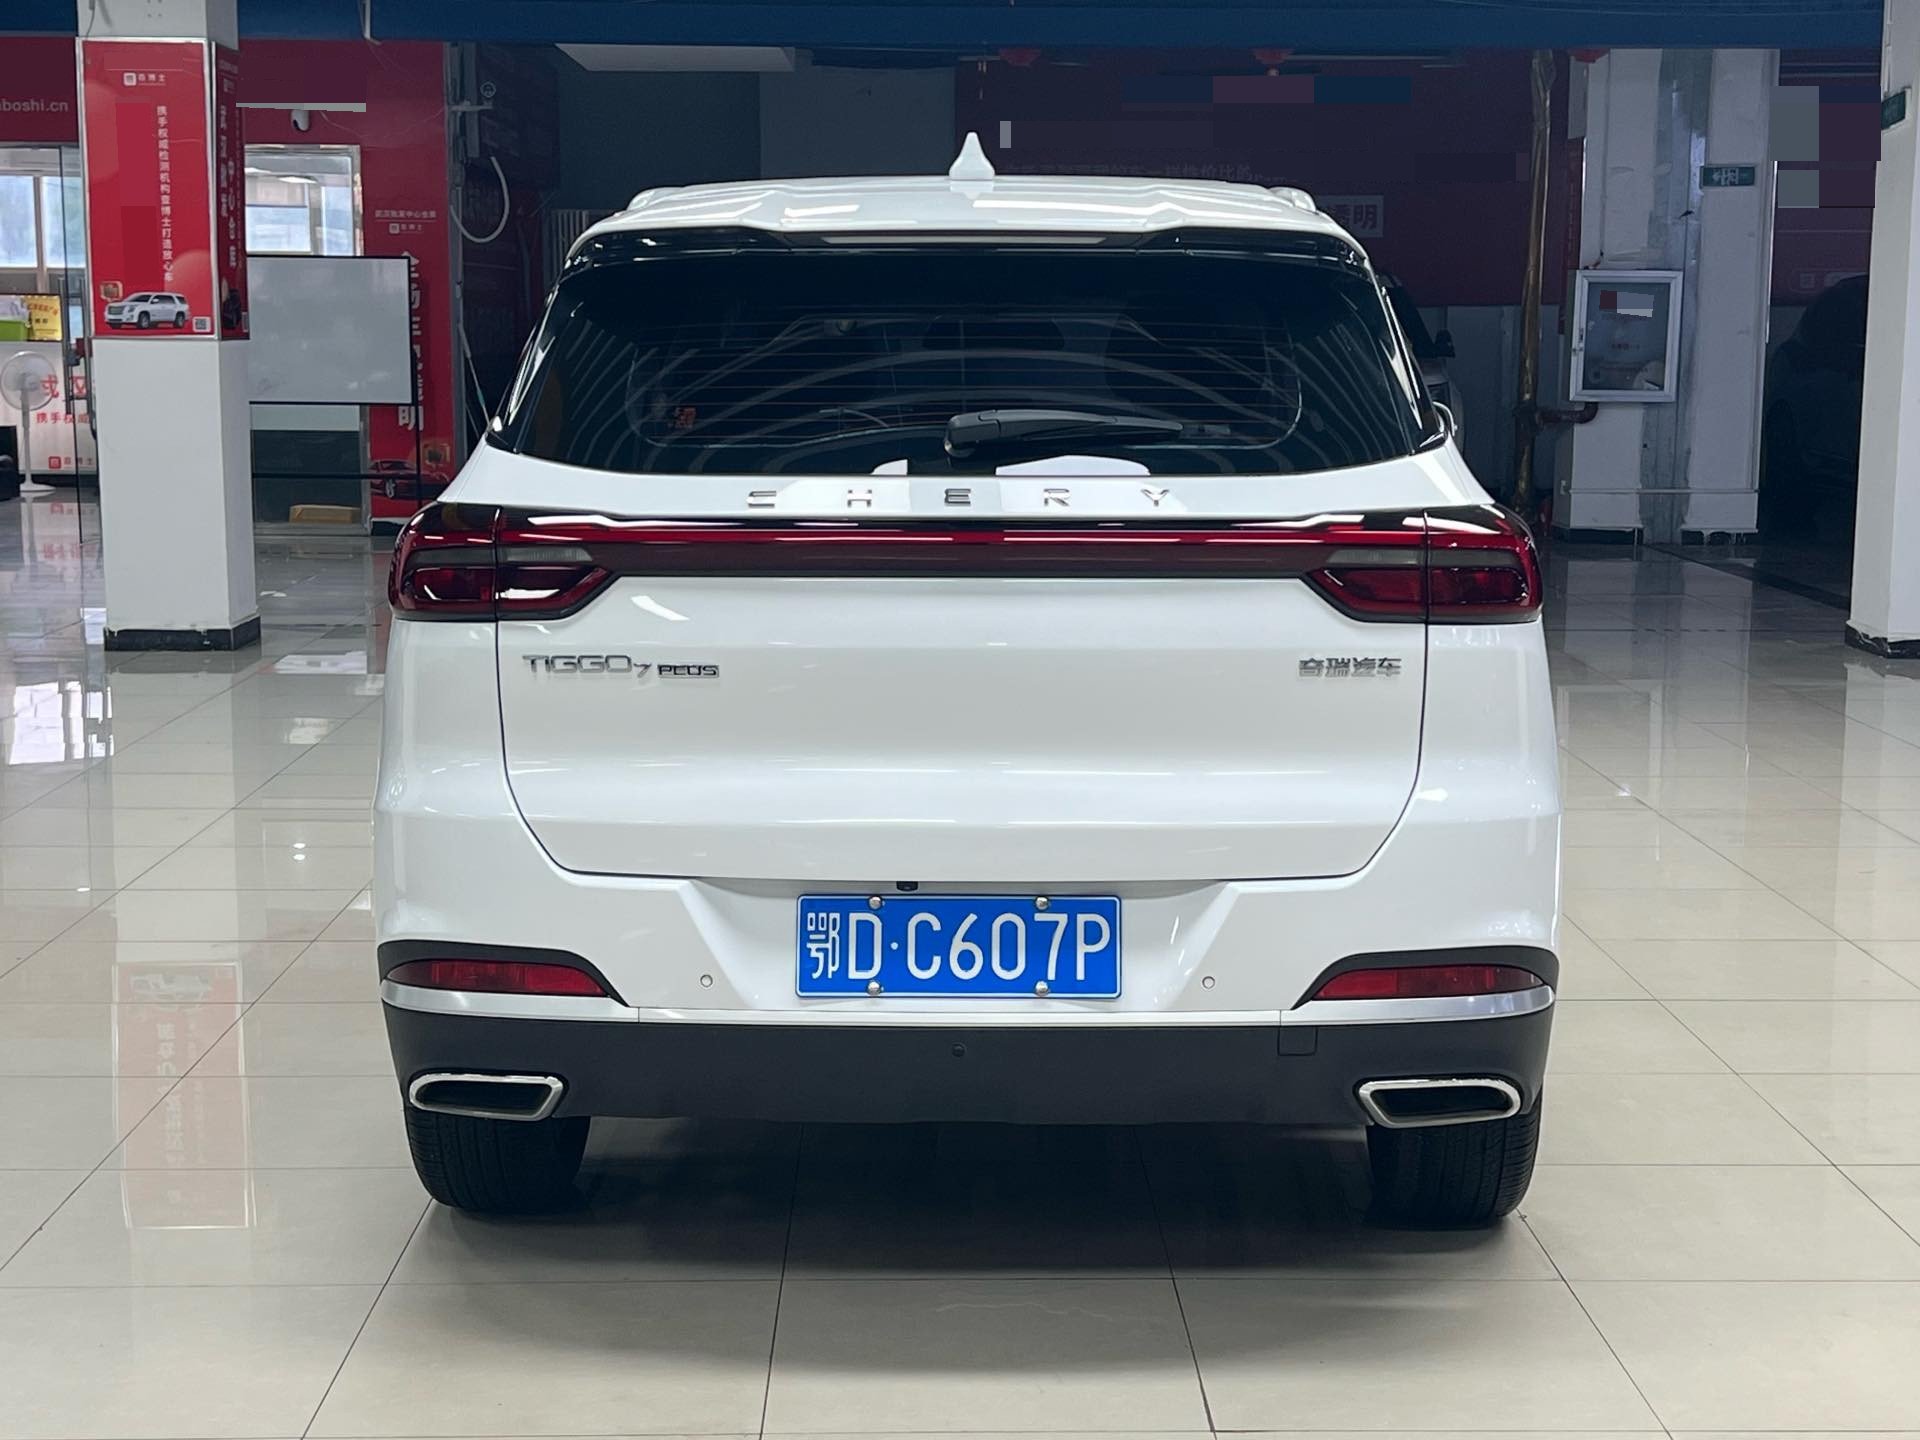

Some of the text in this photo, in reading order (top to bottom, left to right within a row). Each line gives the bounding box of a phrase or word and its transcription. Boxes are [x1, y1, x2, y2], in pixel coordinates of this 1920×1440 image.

[0, 98, 69, 112] boshi.cn
[747, 488, 1171, 508] CHERY
[657, 663, 720, 679] PLUS
[1299, 657, 1402, 678] 奇瑞汽车
